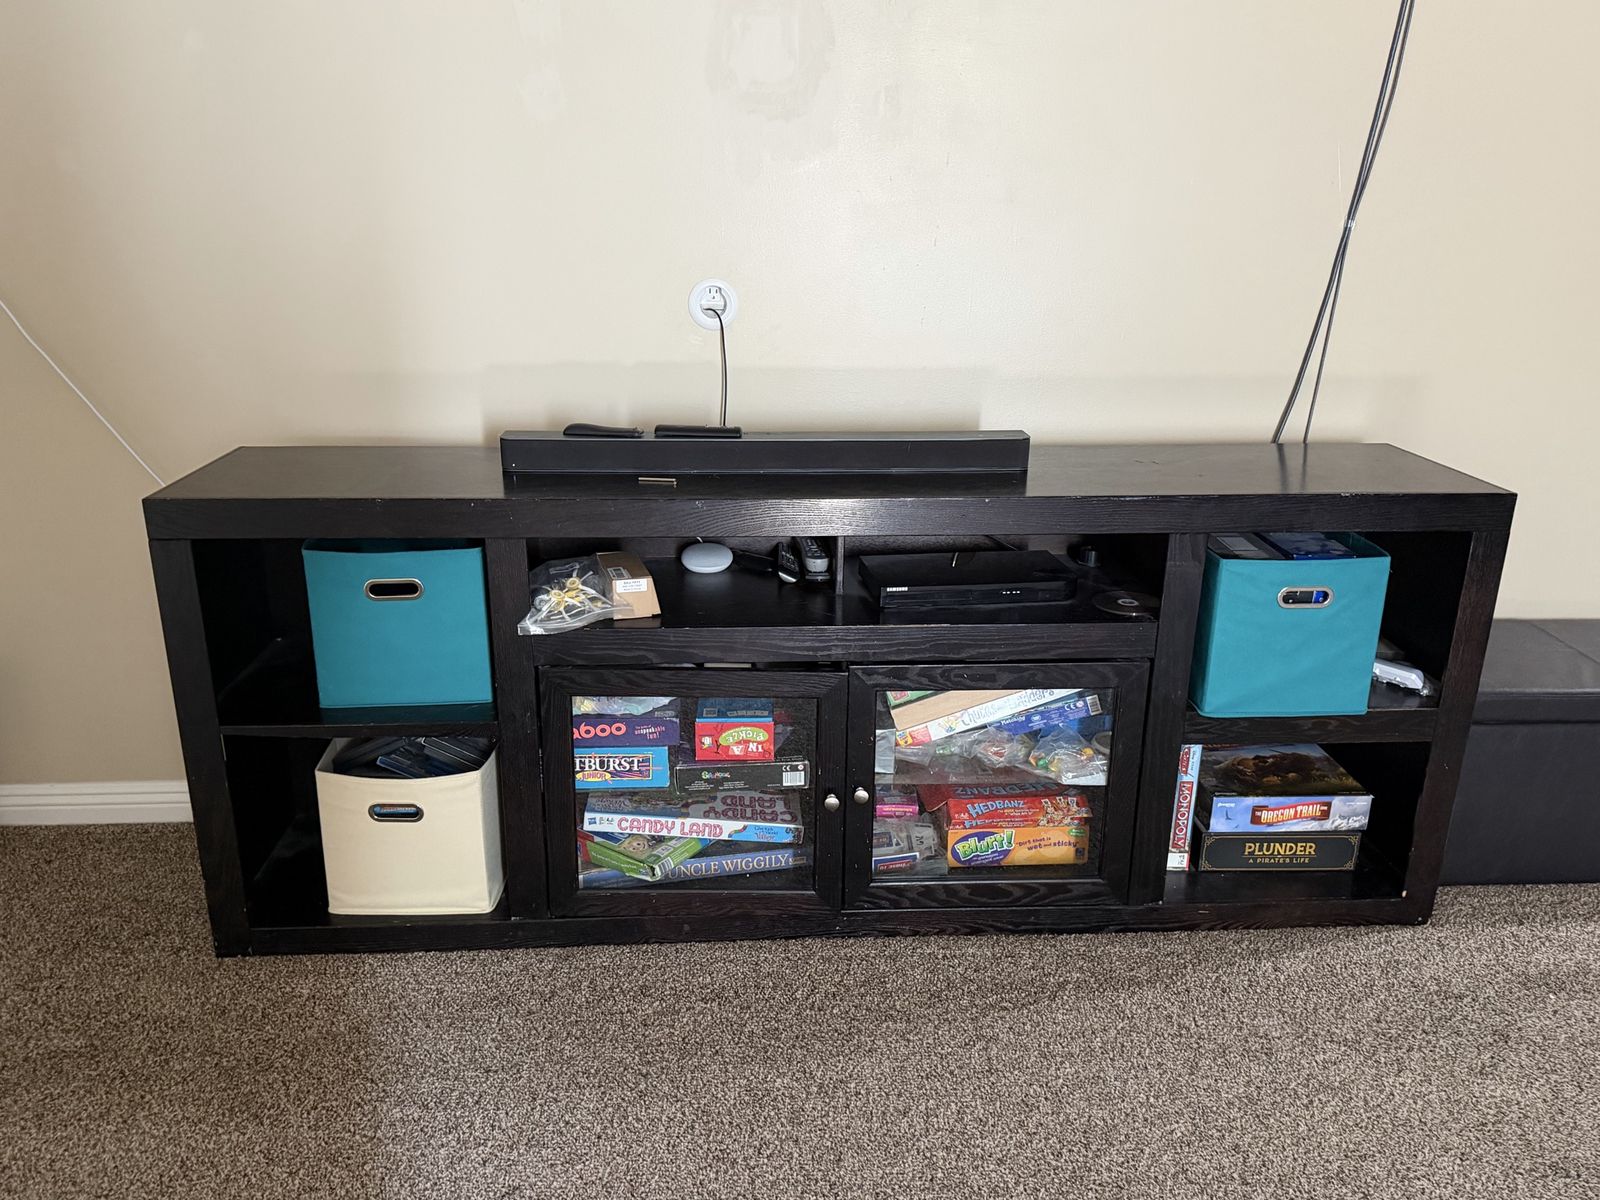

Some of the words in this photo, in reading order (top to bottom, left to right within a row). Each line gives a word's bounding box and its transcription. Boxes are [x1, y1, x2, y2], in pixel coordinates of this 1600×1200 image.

[726, 730, 764, 743] PICKLE
[731, 745, 744, 755] A
[748, 742, 763, 752] IN
[720, 795, 791, 810] LAND
[967, 800, 1025, 818] HEDBANZ
[703, 806, 798, 822] CANDY
[1174, 784, 1192, 848] MONOPOLY
[1261, 807, 1295, 823] OREGON
[1296, 804, 1321, 818] TRAIL
[617, 817, 675, 834] CANDY
[680, 821, 723, 838] LAND
[954, 829, 1015, 860] Blurt!
[1244, 843, 1316, 855] PLUNDER
[668, 861, 720, 879] UNCLE
[722, 854, 789, 872] WIGGILY
